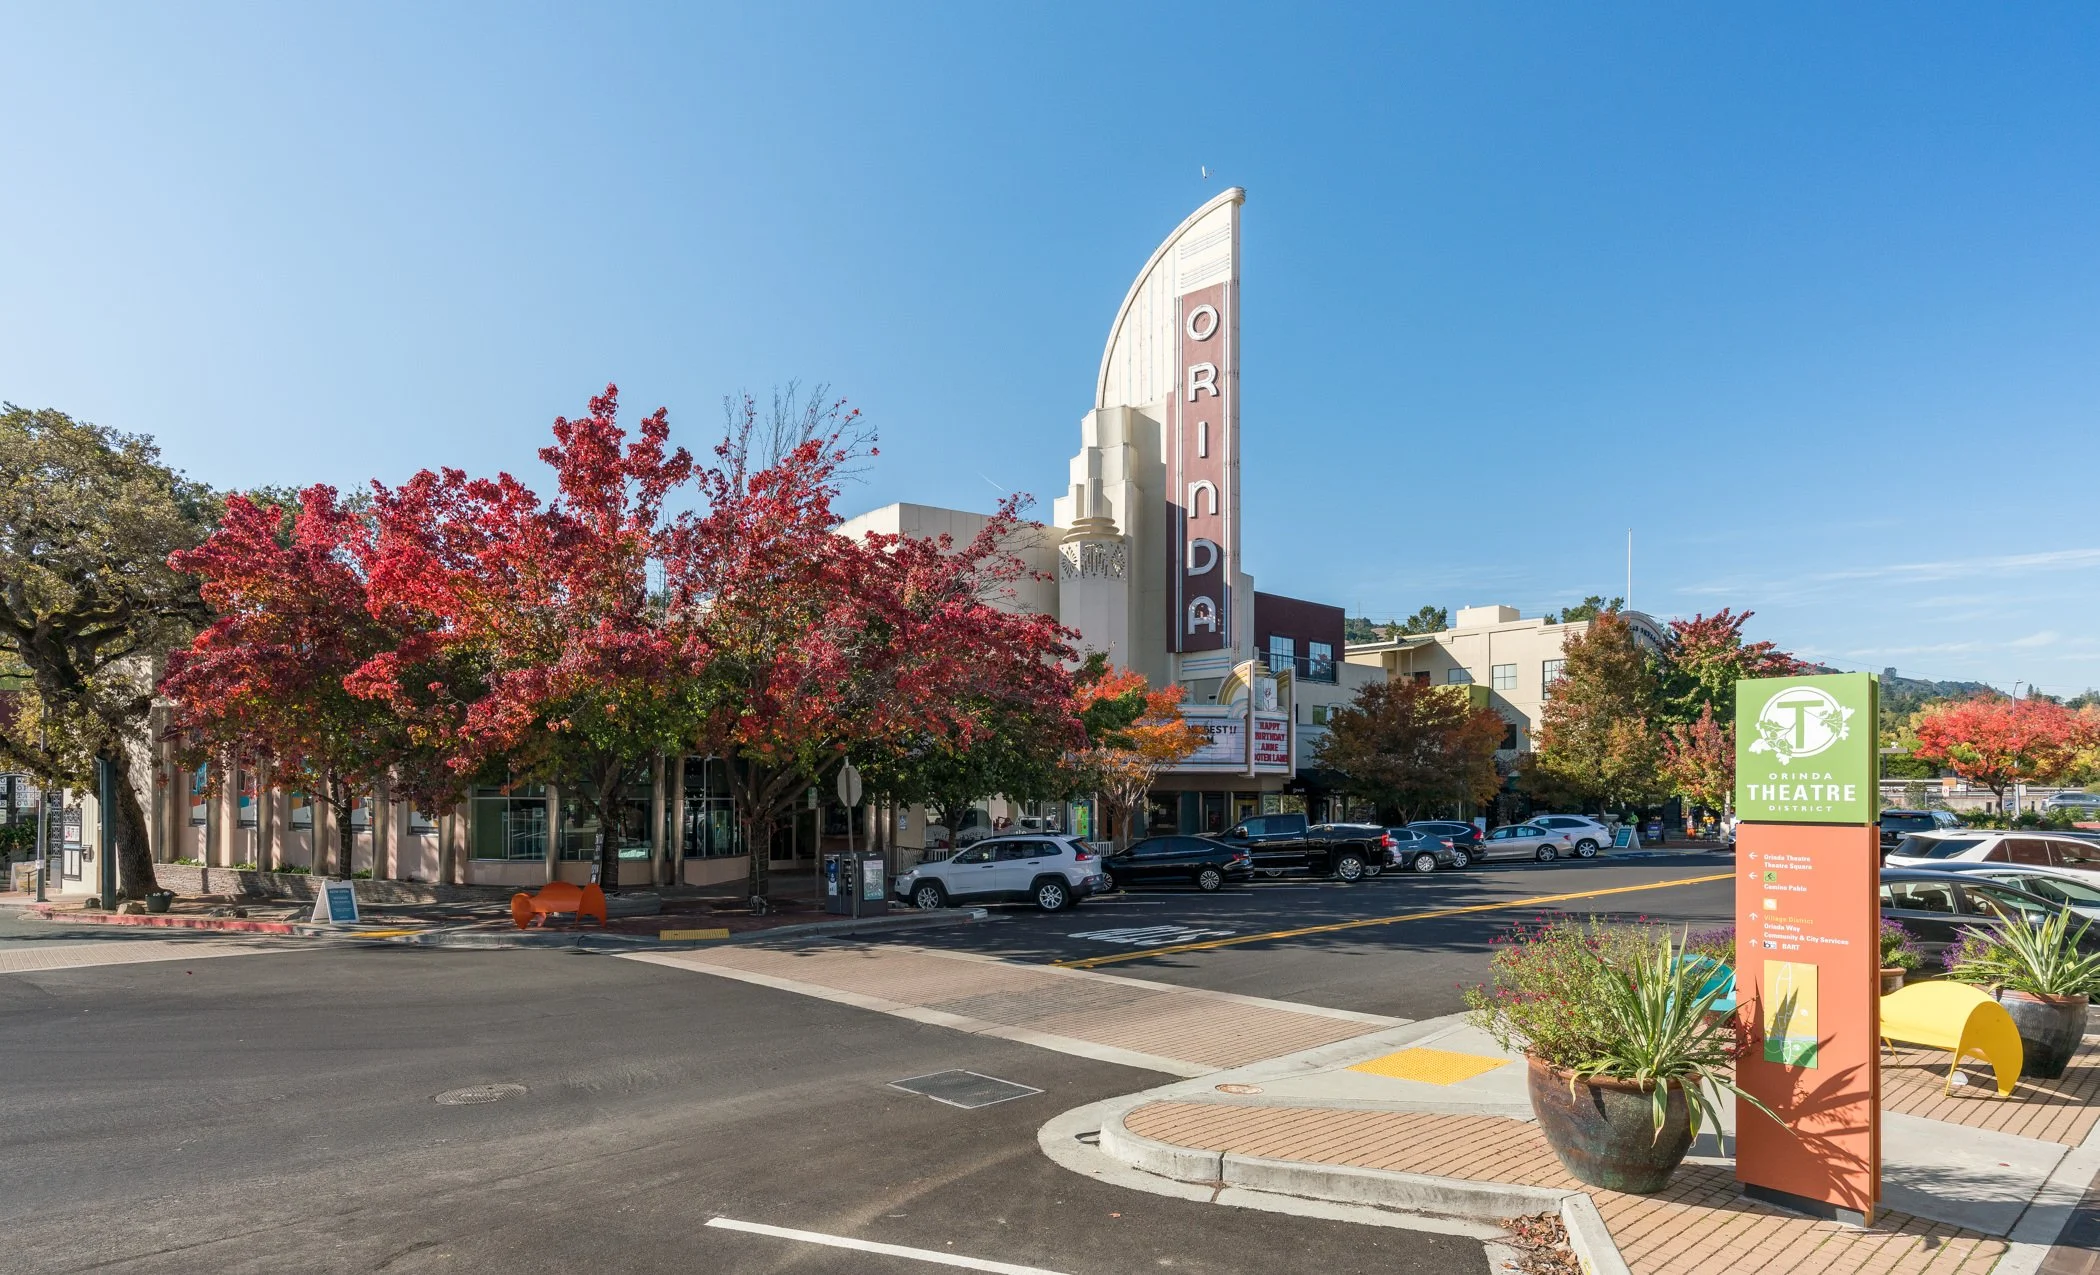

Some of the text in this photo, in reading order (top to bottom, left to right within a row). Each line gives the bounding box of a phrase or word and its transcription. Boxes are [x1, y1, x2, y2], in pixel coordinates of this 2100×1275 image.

[1259, 722, 1281, 731] HAPPY
[1255, 733, 1285, 742] BIRTHDAY
[1768, 772, 1833, 780] ORINDA
[1746, 784, 1857, 802] THEATRE
[1764, 914, 1813, 924] Village District
[1786, 924, 1800, 932] Way
[1763, 932, 1798, 941] Community
[1820, 937, 1849, 945] Services
